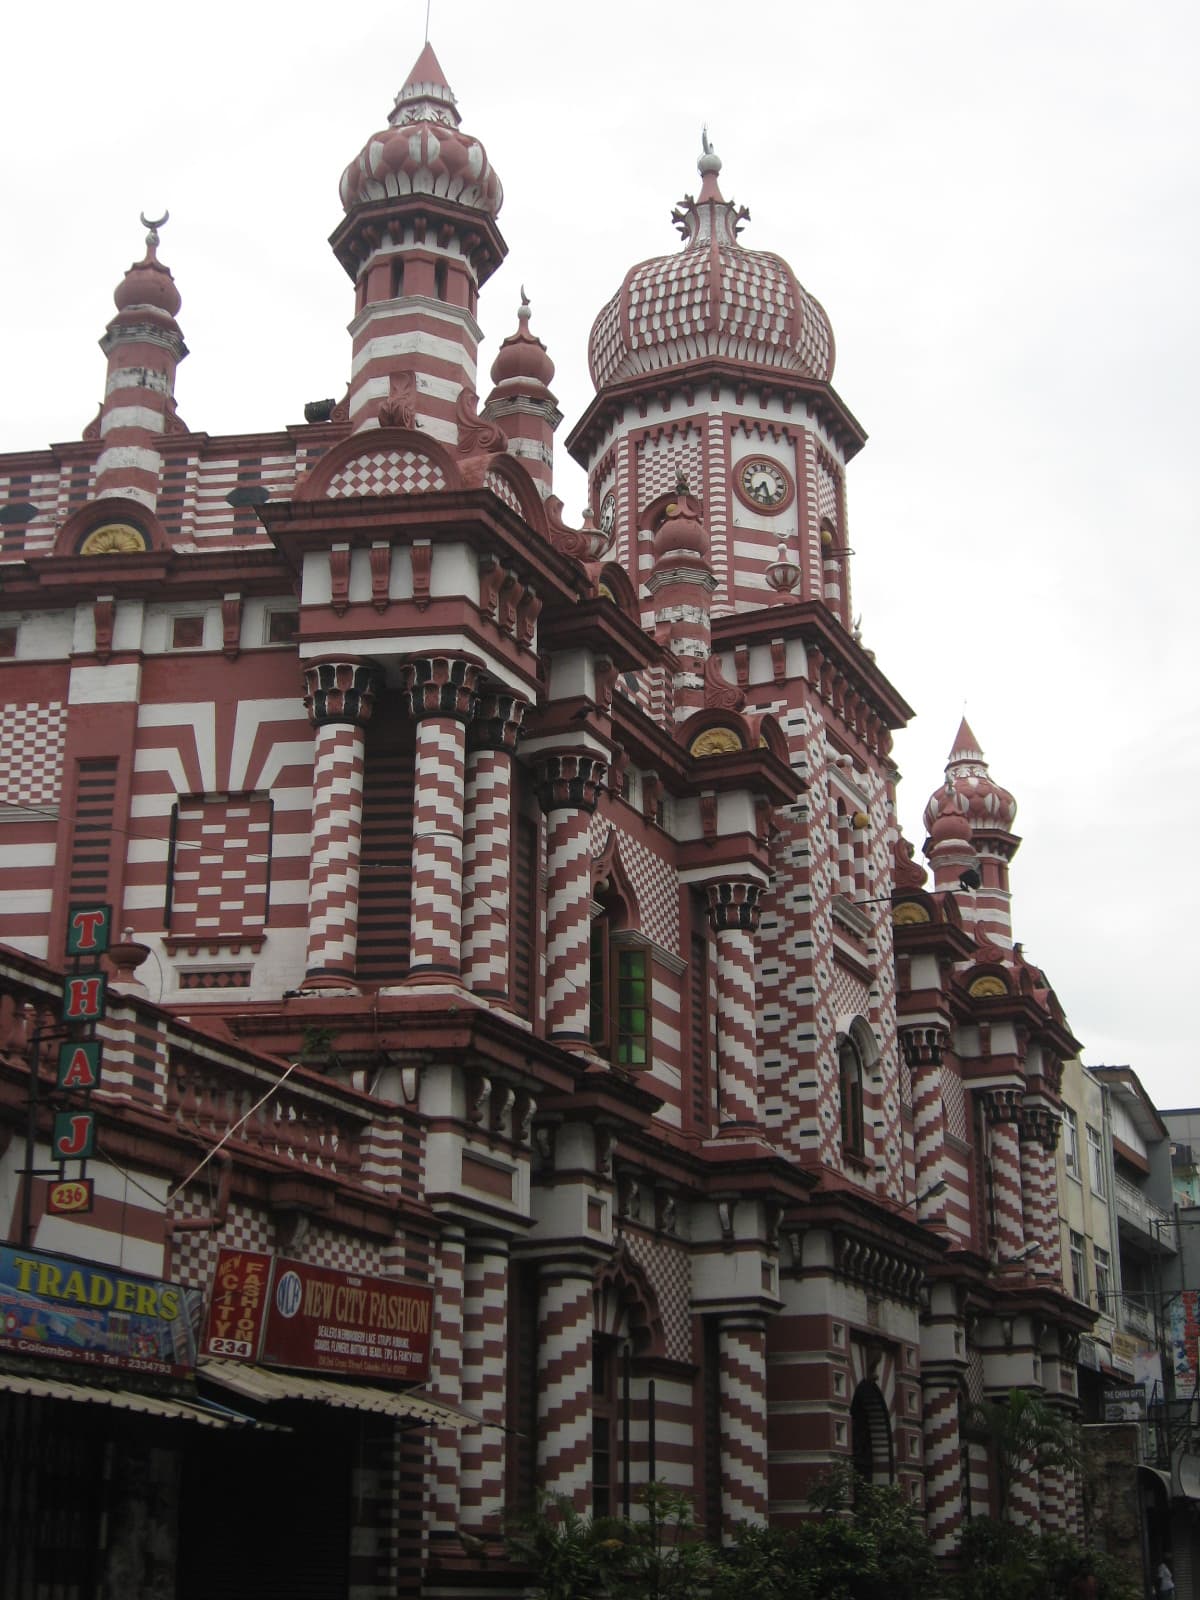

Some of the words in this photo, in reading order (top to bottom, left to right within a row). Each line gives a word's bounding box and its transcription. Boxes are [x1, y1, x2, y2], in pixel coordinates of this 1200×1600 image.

[57, 911, 104, 1154] THAJ
[56, 1188, 83, 1205] 236
[14, 1257, 179, 1321] TRADERS
[219, 1255, 242, 1277] NEW
[216, 1274, 240, 1338] CITY
[235, 1263, 264, 1341] FASHION
[304, 1279, 335, 1319] NEW
[335, 1286, 367, 1325] CITY
[368, 1291, 429, 1334] FASHION
[18, 1340, 73, 1358] Colombo
[103, 1353, 119, 1366] Tel
[128, 1359, 172, 1374] 2334793
[213, 1340, 248, 1355] 234
